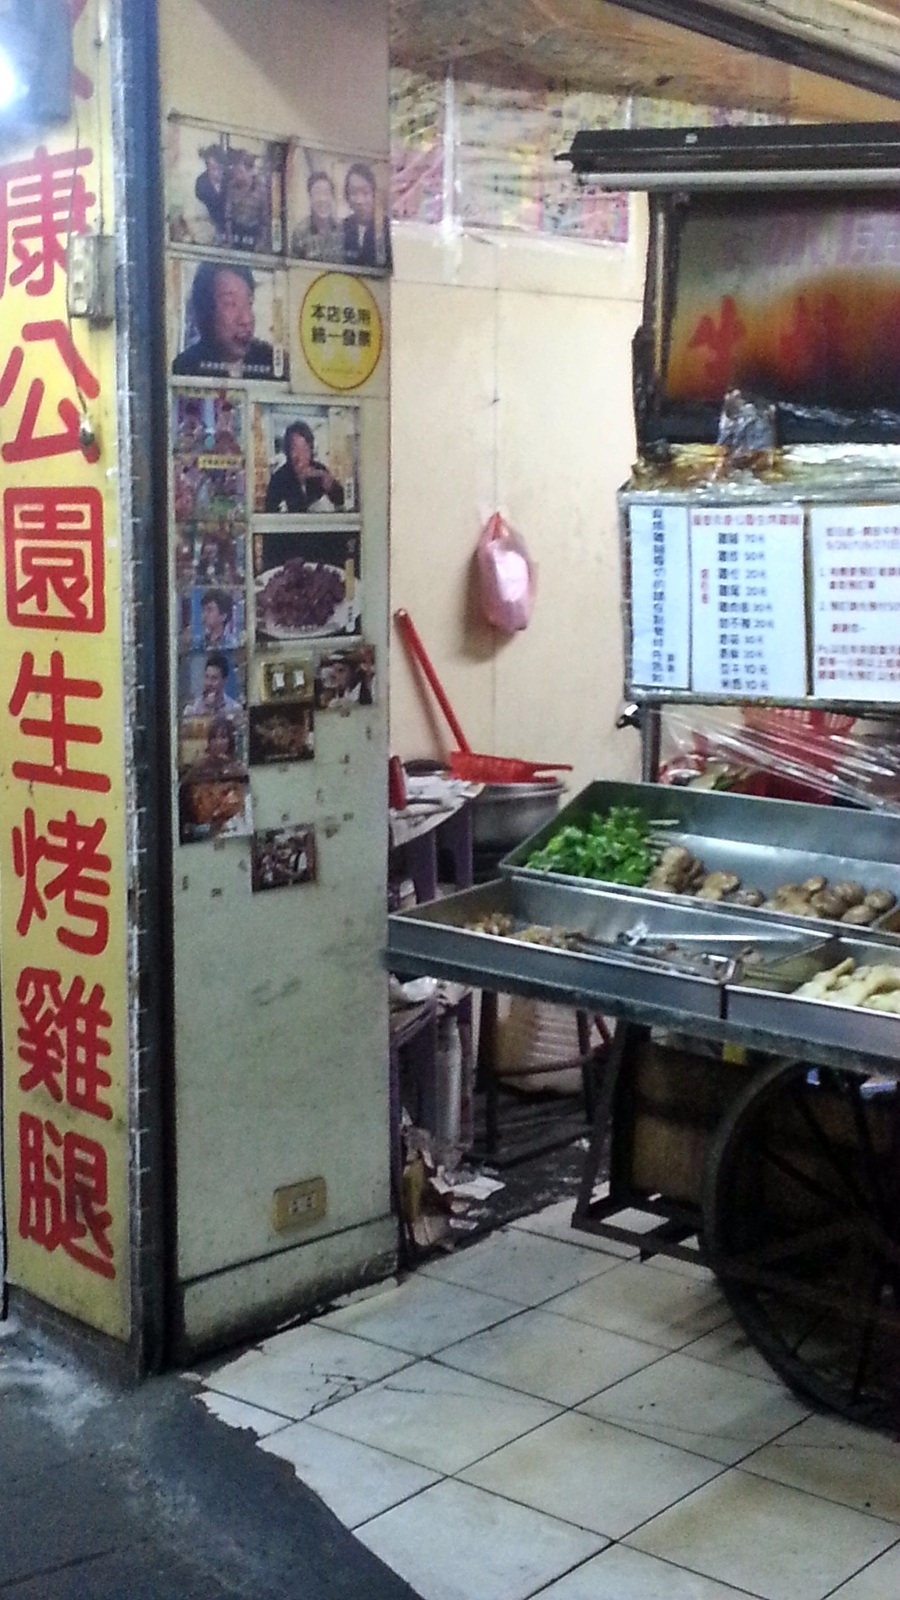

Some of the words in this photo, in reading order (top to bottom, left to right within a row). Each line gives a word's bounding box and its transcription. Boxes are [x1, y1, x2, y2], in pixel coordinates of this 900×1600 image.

[311, 303, 371, 326] 本店免用
[311, 327, 371, 347] 統一發票
[0, 0, 116, 1280] 康公園生烤雞腿
